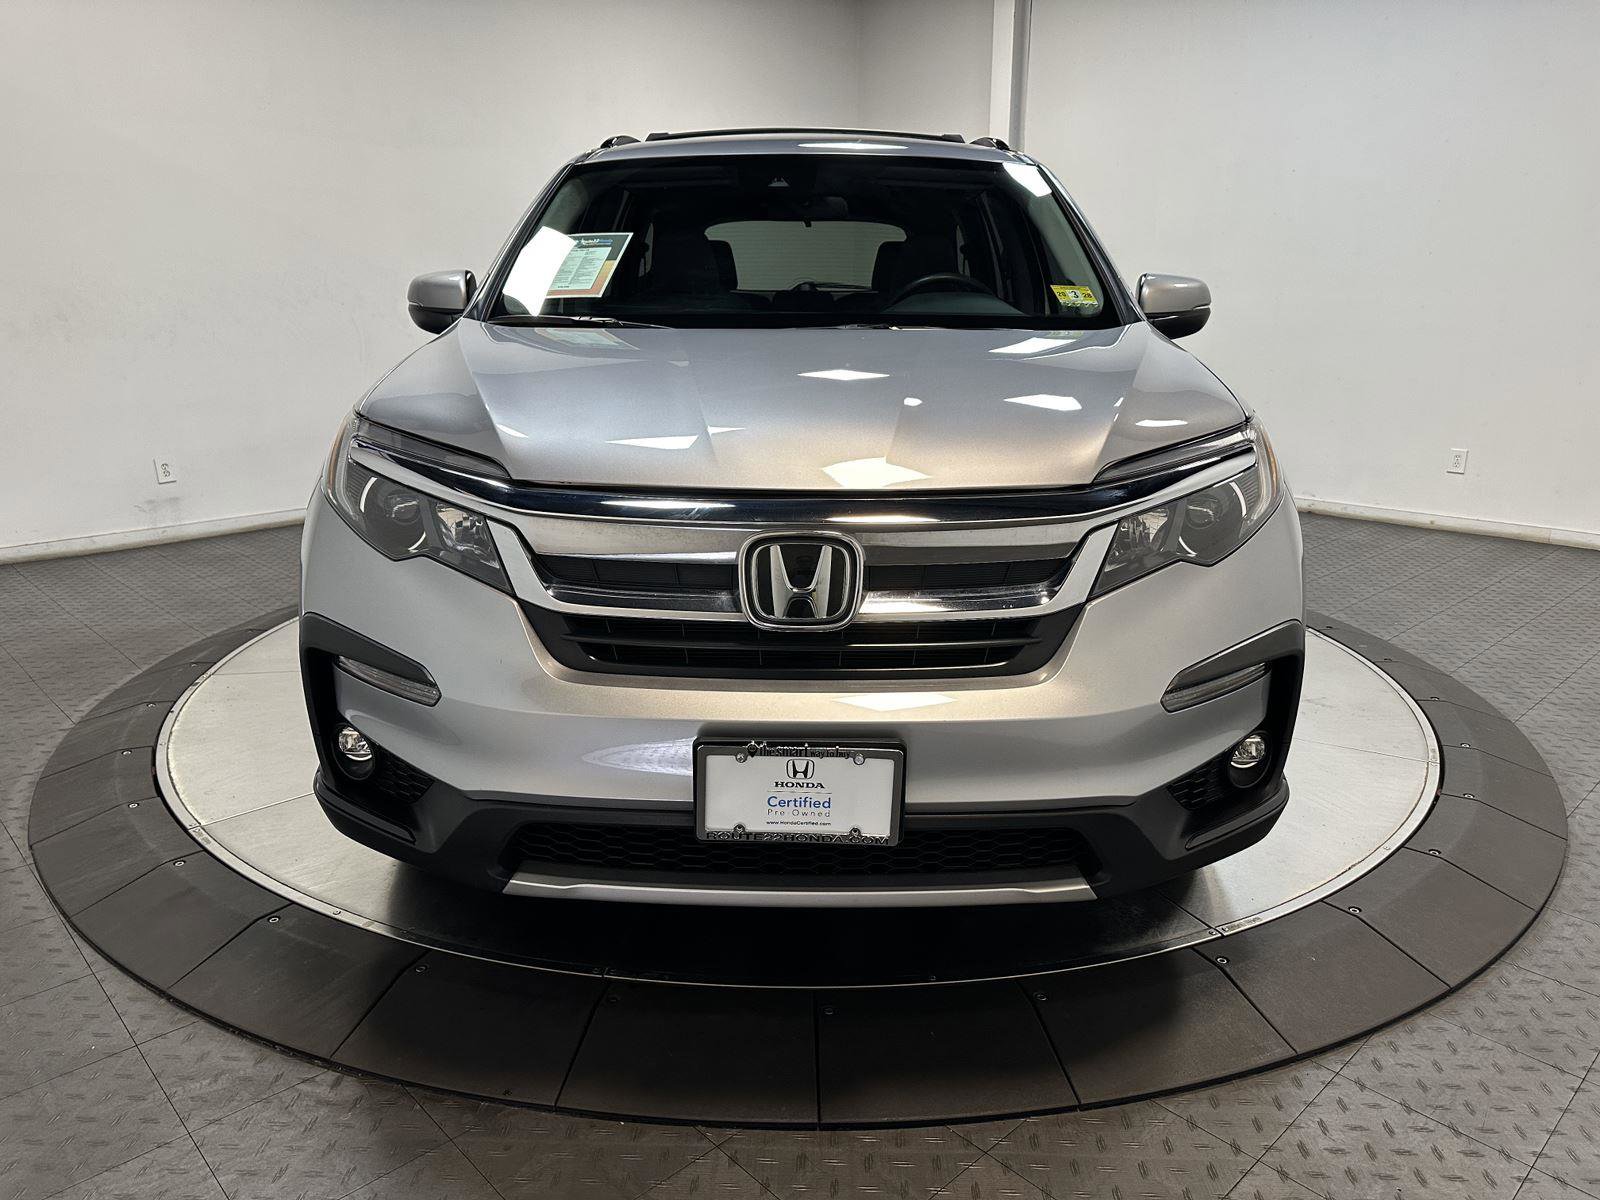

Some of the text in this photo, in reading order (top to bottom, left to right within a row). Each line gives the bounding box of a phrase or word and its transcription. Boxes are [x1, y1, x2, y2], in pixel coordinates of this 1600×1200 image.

[1070, 290, 1079, 298] 3
[810, 750, 825, 759] way
[774, 781, 825, 789] HONDA
[767, 796, 832, 809] Certified
[792, 809, 831, 817] Owned
[706, 831, 889, 845] ROUTE22HONDA.COM
